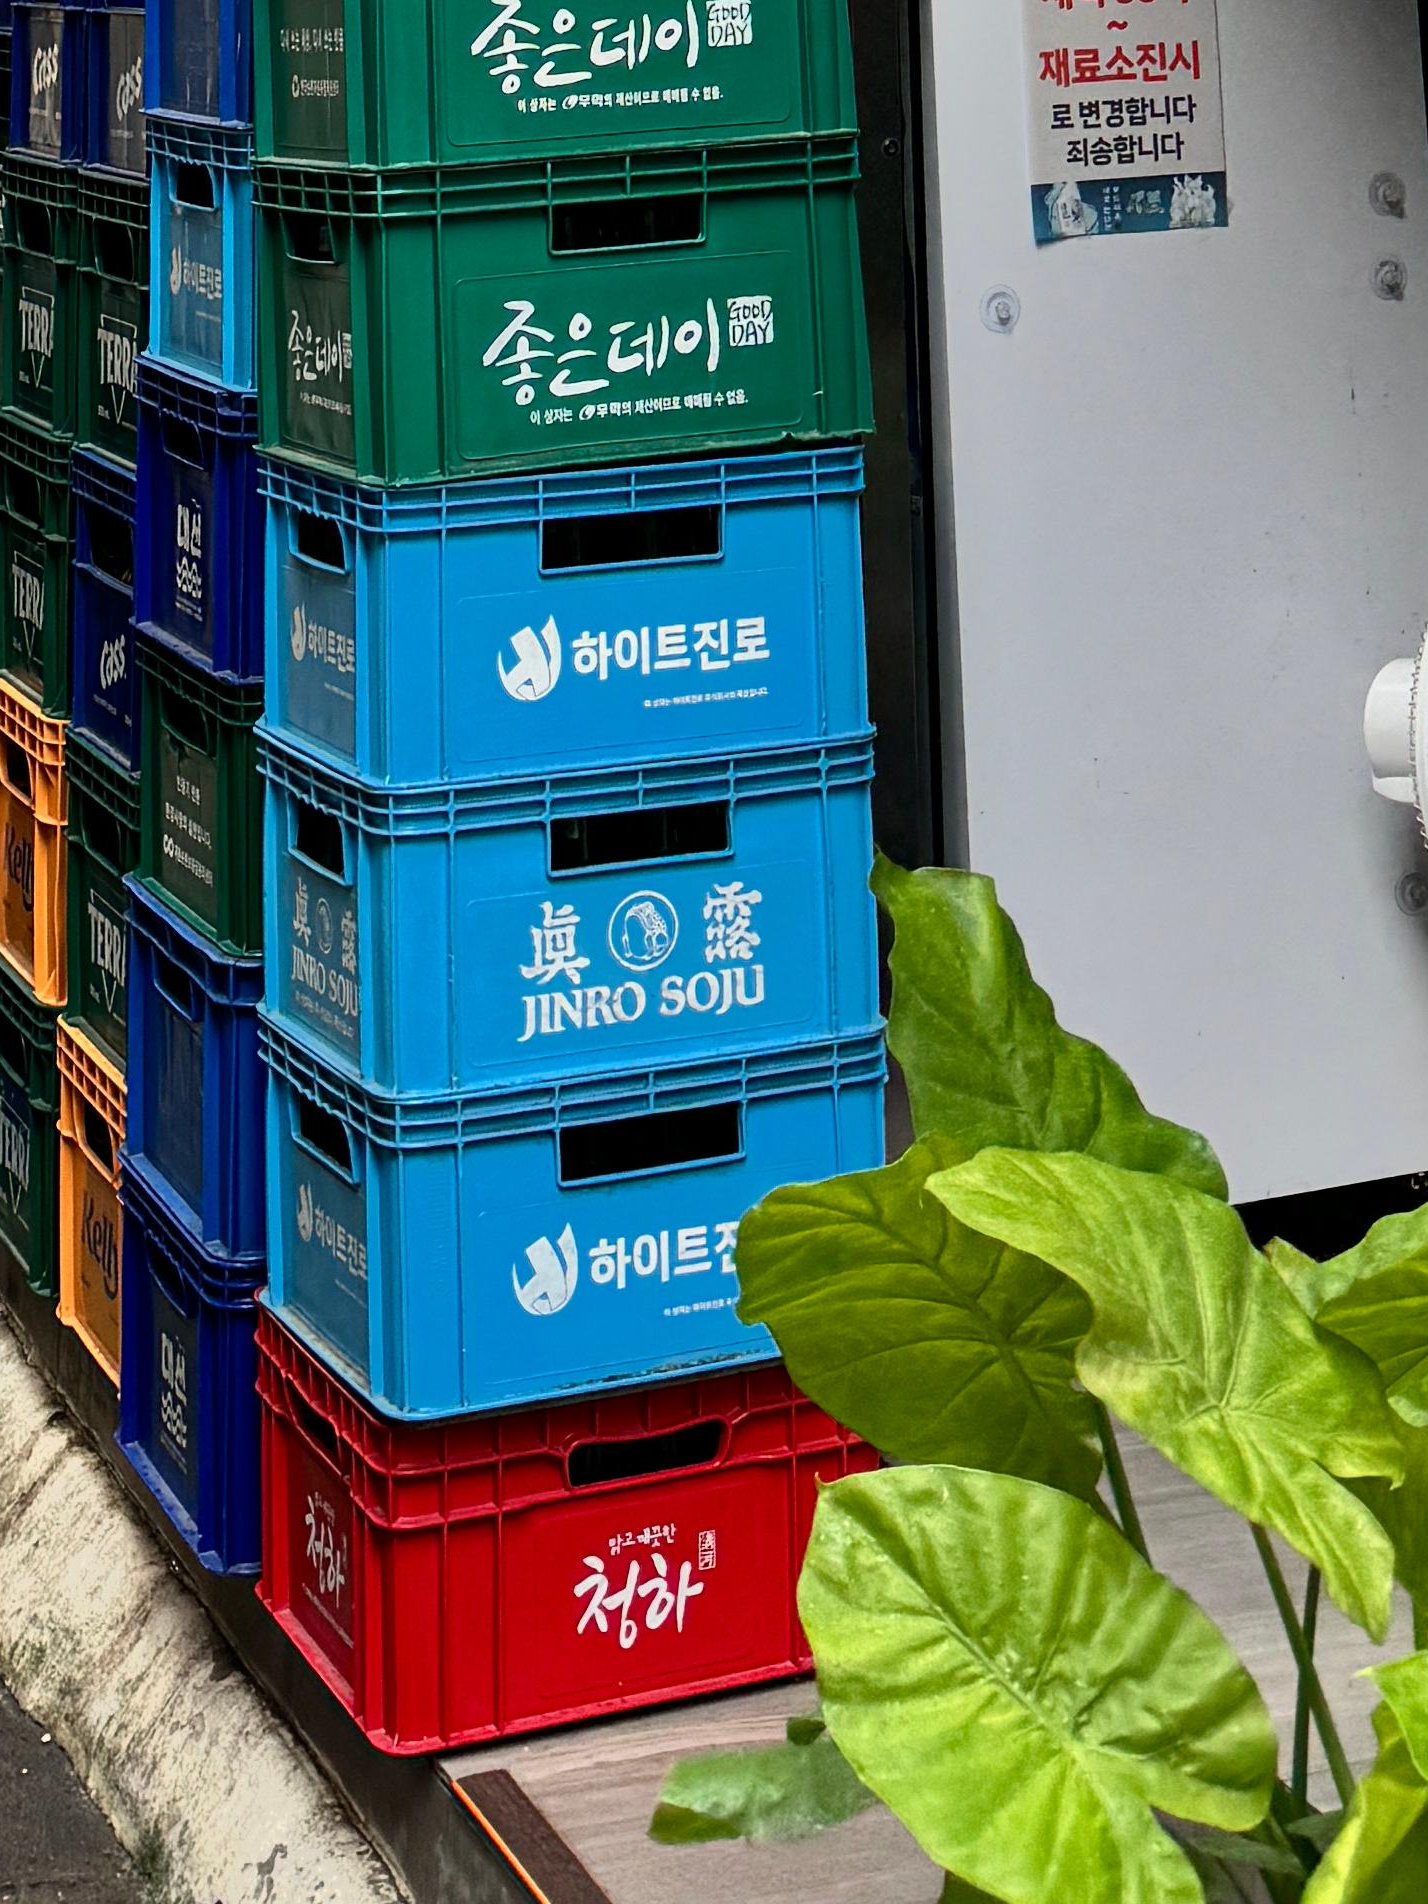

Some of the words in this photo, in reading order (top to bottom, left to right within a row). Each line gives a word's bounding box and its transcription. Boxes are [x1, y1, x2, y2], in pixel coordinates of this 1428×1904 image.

[710, 20, 751, 48] DAY
[1038, 39, 1201, 89] 재료소진시
[1050, 102, 1075, 130] 로
[1078, 93, 1198, 129] 변경합니다
[1066, 131, 1185, 167] 죄송합니다
[482, 296, 722, 406] 좋은데이
[731, 319, 772, 346] DAY
[571, 616, 771, 681] 하이트진로
[290, 945, 327, 996] JINRO
[515, 980, 647, 1043] JINRO
[658, 964, 766, 1017] SOJU
[573, 1552, 705, 1649] 청하
